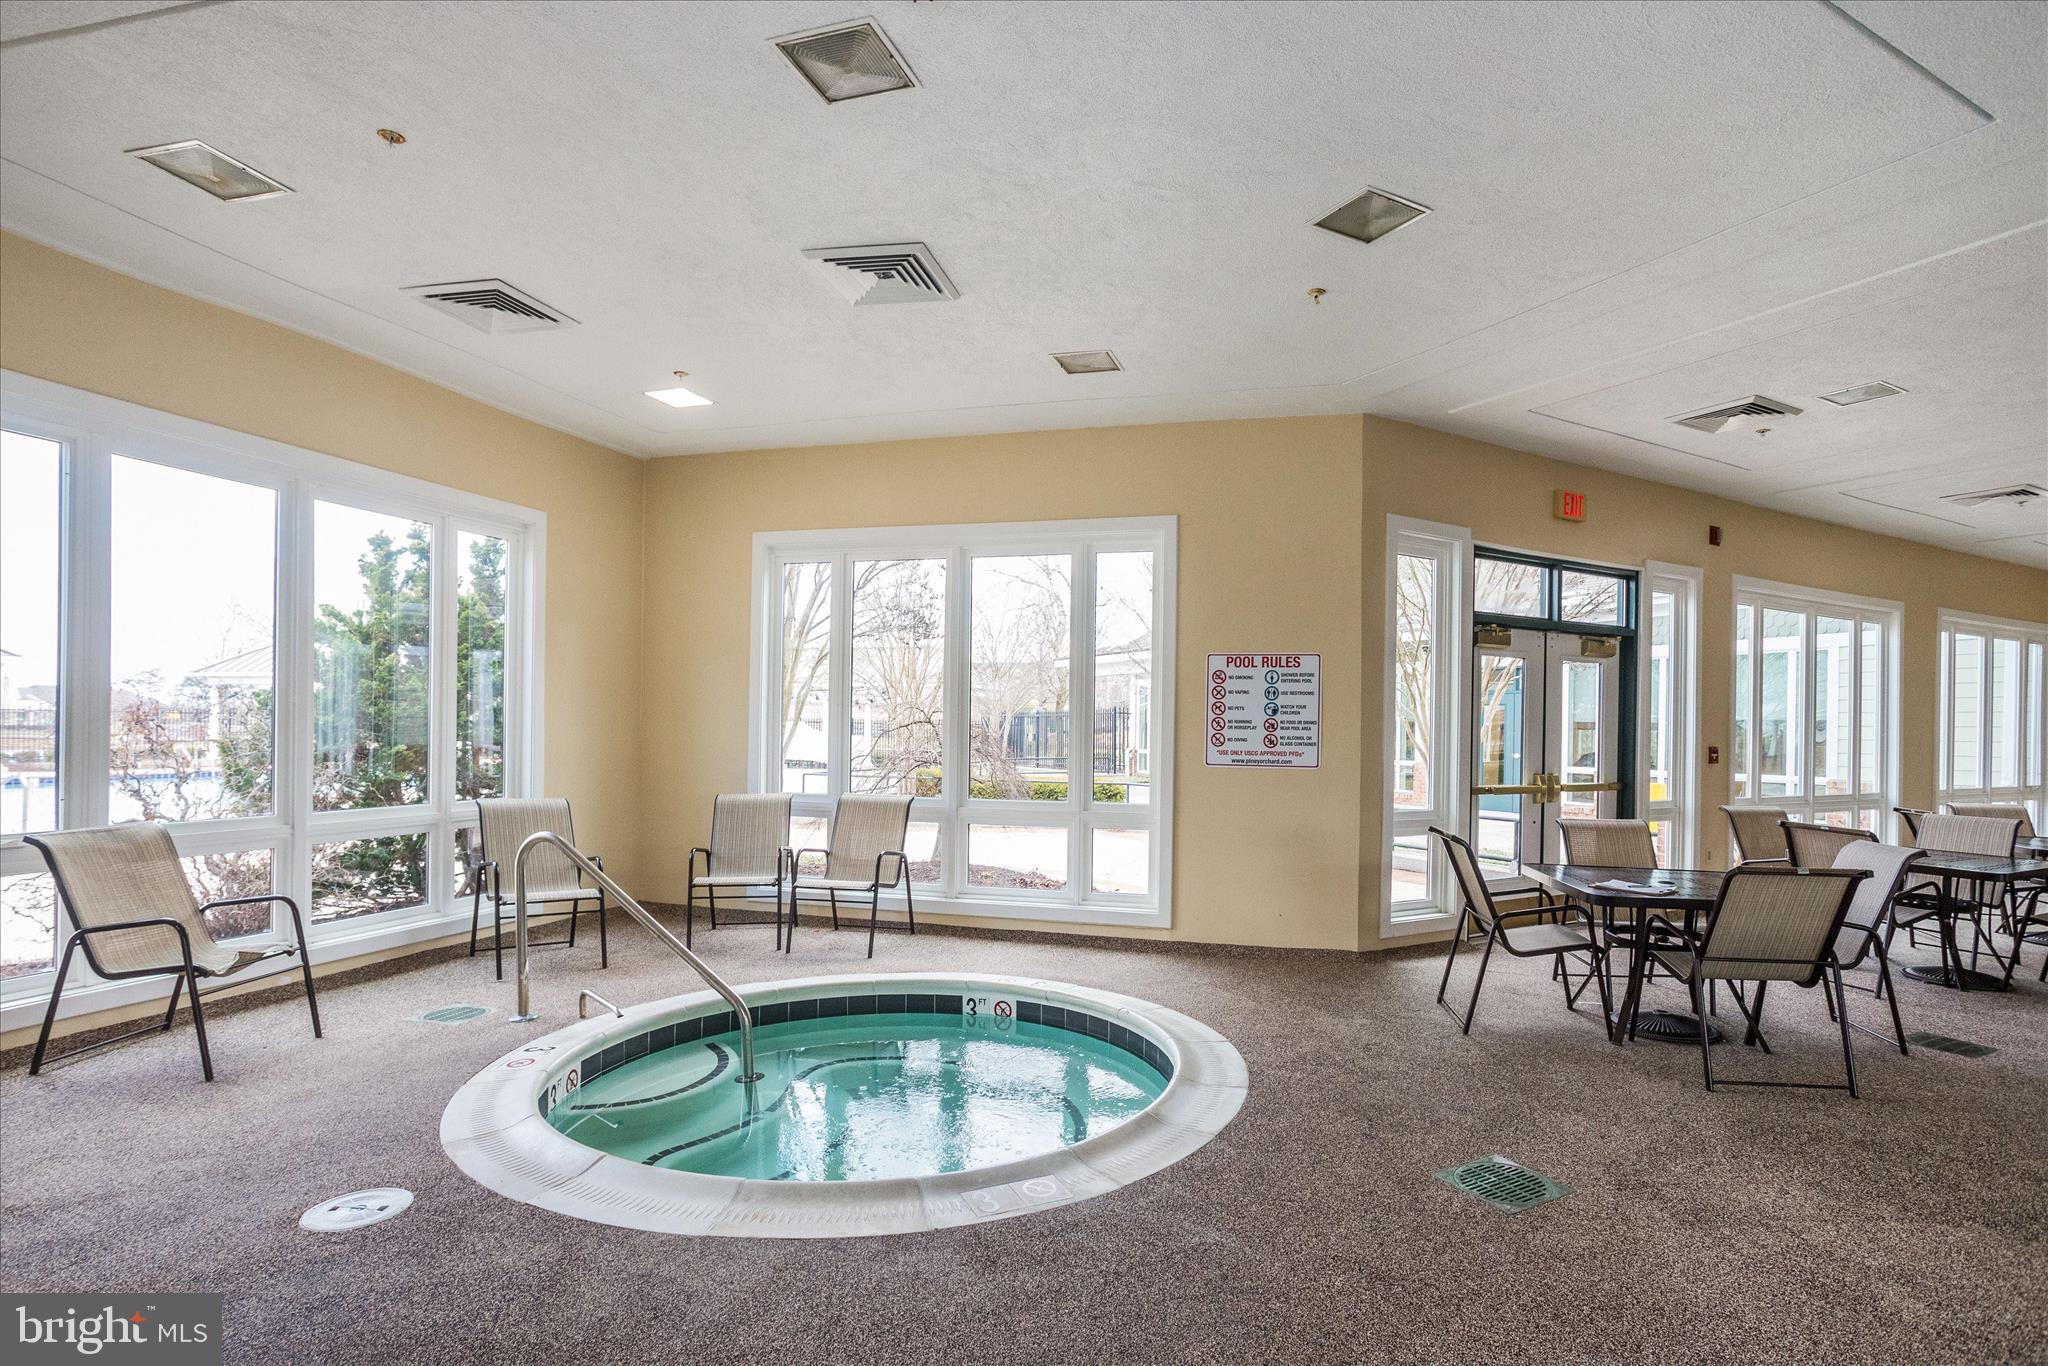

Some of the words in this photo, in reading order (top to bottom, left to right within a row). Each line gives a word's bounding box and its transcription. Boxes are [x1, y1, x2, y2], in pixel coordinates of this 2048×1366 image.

[1564, 491, 1584, 517] EXIT
[1226, 656, 1258, 668] POOL
[1262, 656, 1301, 668] RULES
[966, 998, 977, 1015] 3
[550, 1084, 556, 1112] 3
[972, 1190, 1000, 1212] 3
